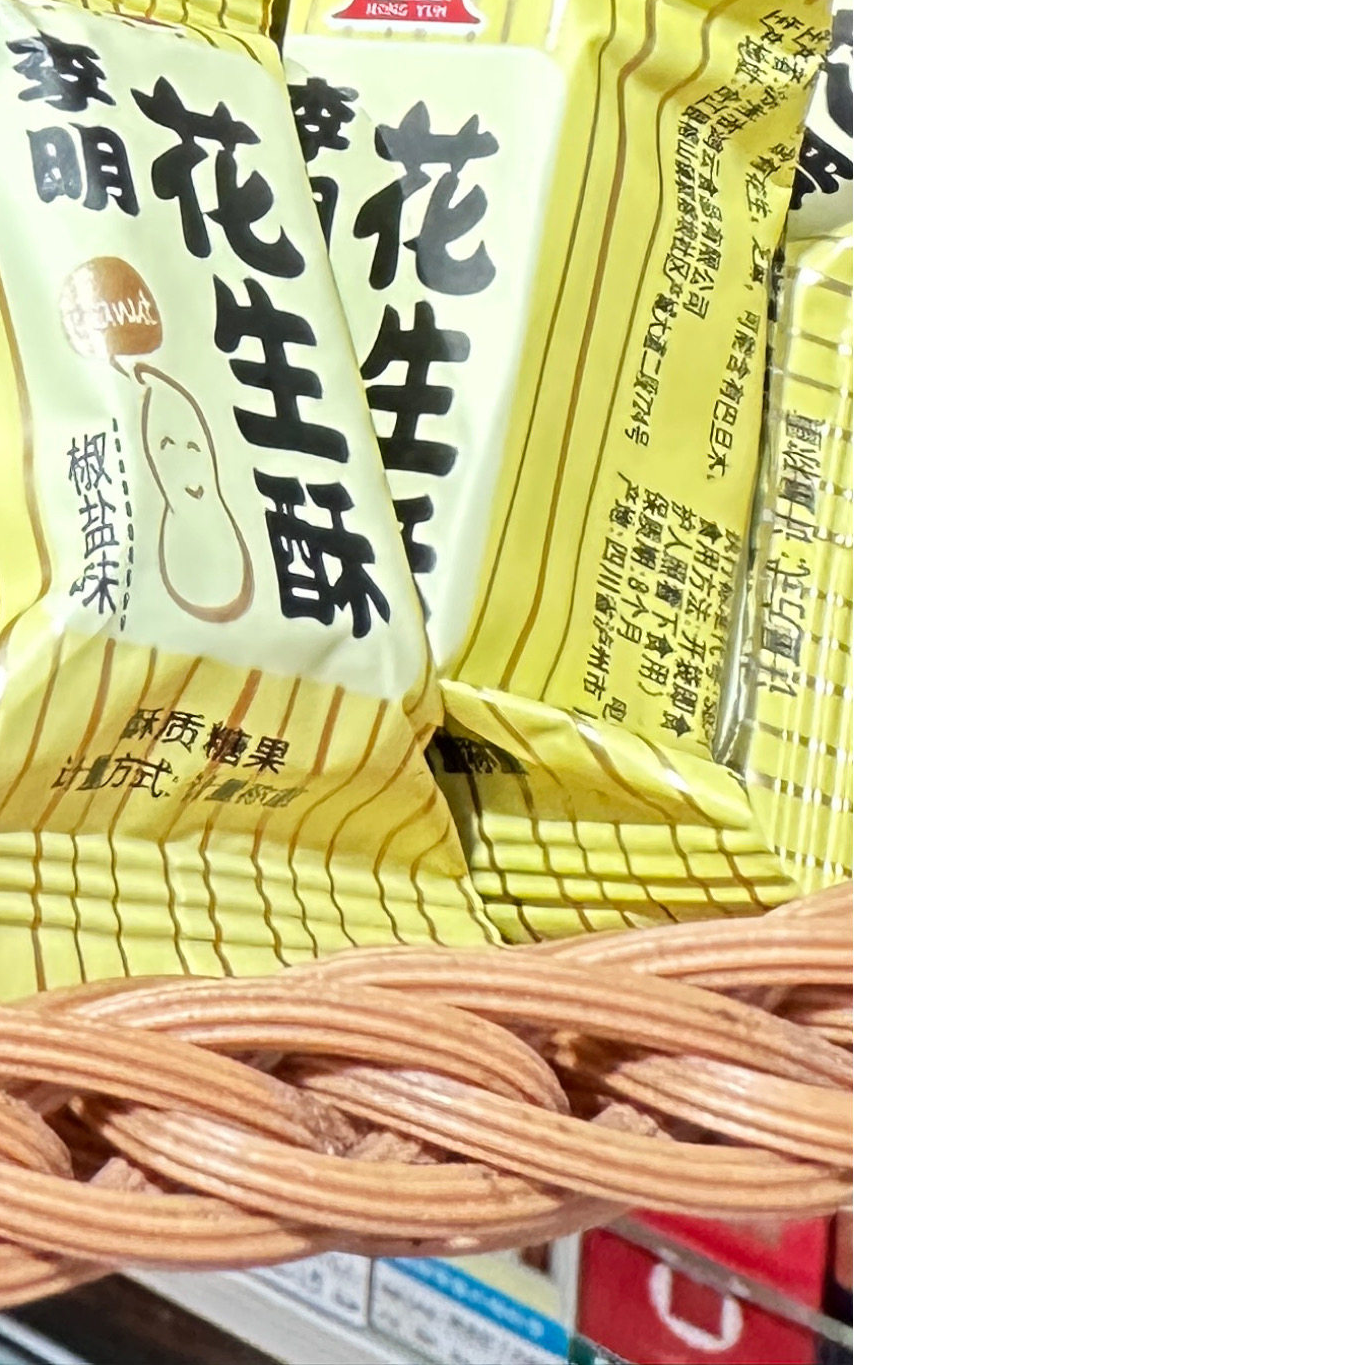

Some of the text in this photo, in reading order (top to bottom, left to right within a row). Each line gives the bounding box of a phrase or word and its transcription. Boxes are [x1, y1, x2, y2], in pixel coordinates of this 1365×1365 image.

[5, 30, 142, 218] 李明
[130, 74, 392, 640] 花生酥
[66, 431, 122, 615] 椒盐味
[121, 705, 292, 776] 酥质糖果
